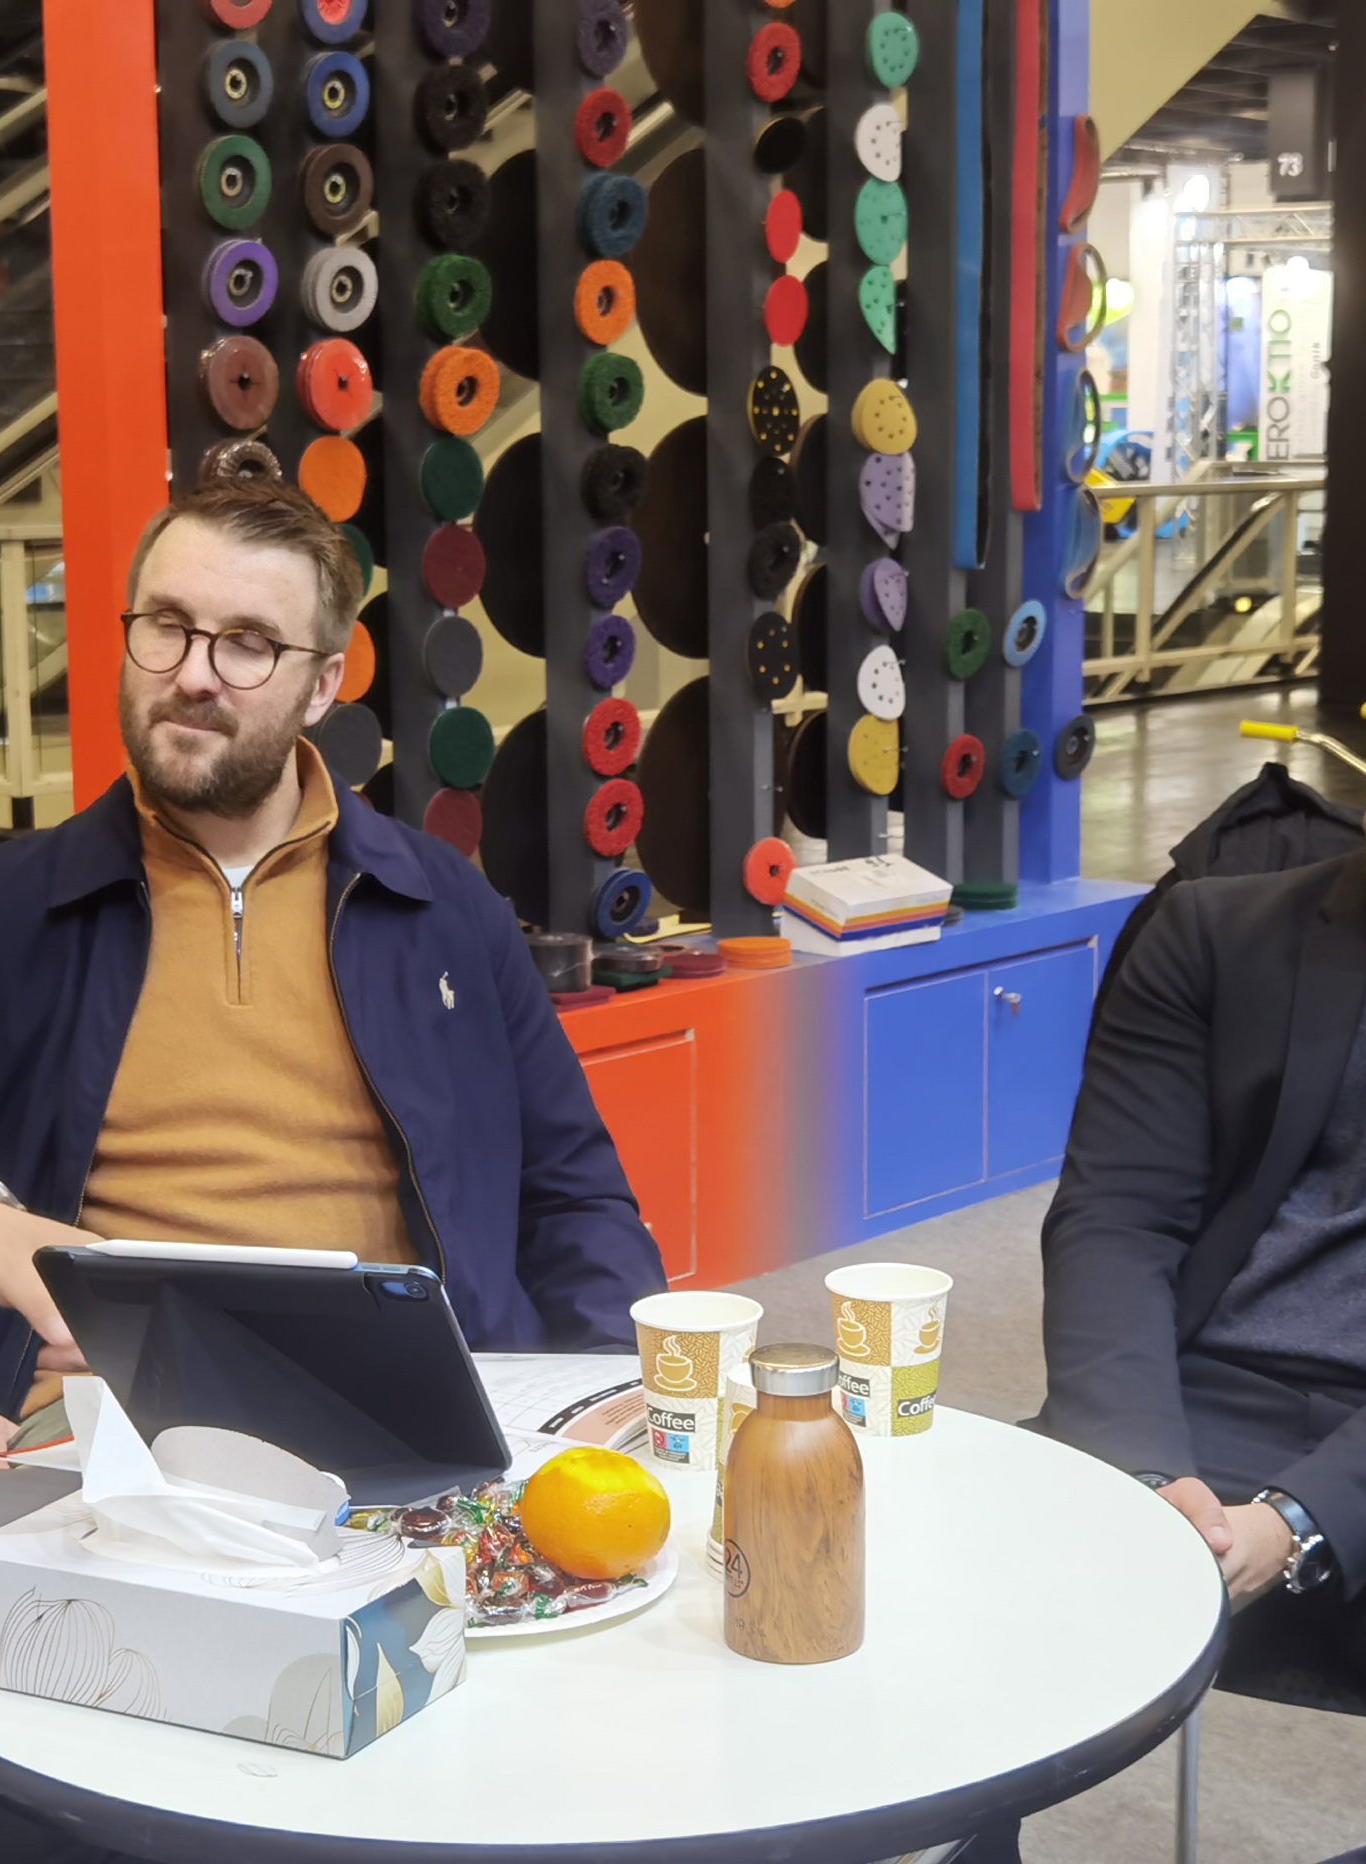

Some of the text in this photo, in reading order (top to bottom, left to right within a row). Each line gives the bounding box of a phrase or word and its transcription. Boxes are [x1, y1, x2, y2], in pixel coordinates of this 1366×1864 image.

[1278, 152, 1303, 176] 73
[839, 1374, 870, 1396] offee
[647, 1406, 695, 1431] Coffee
